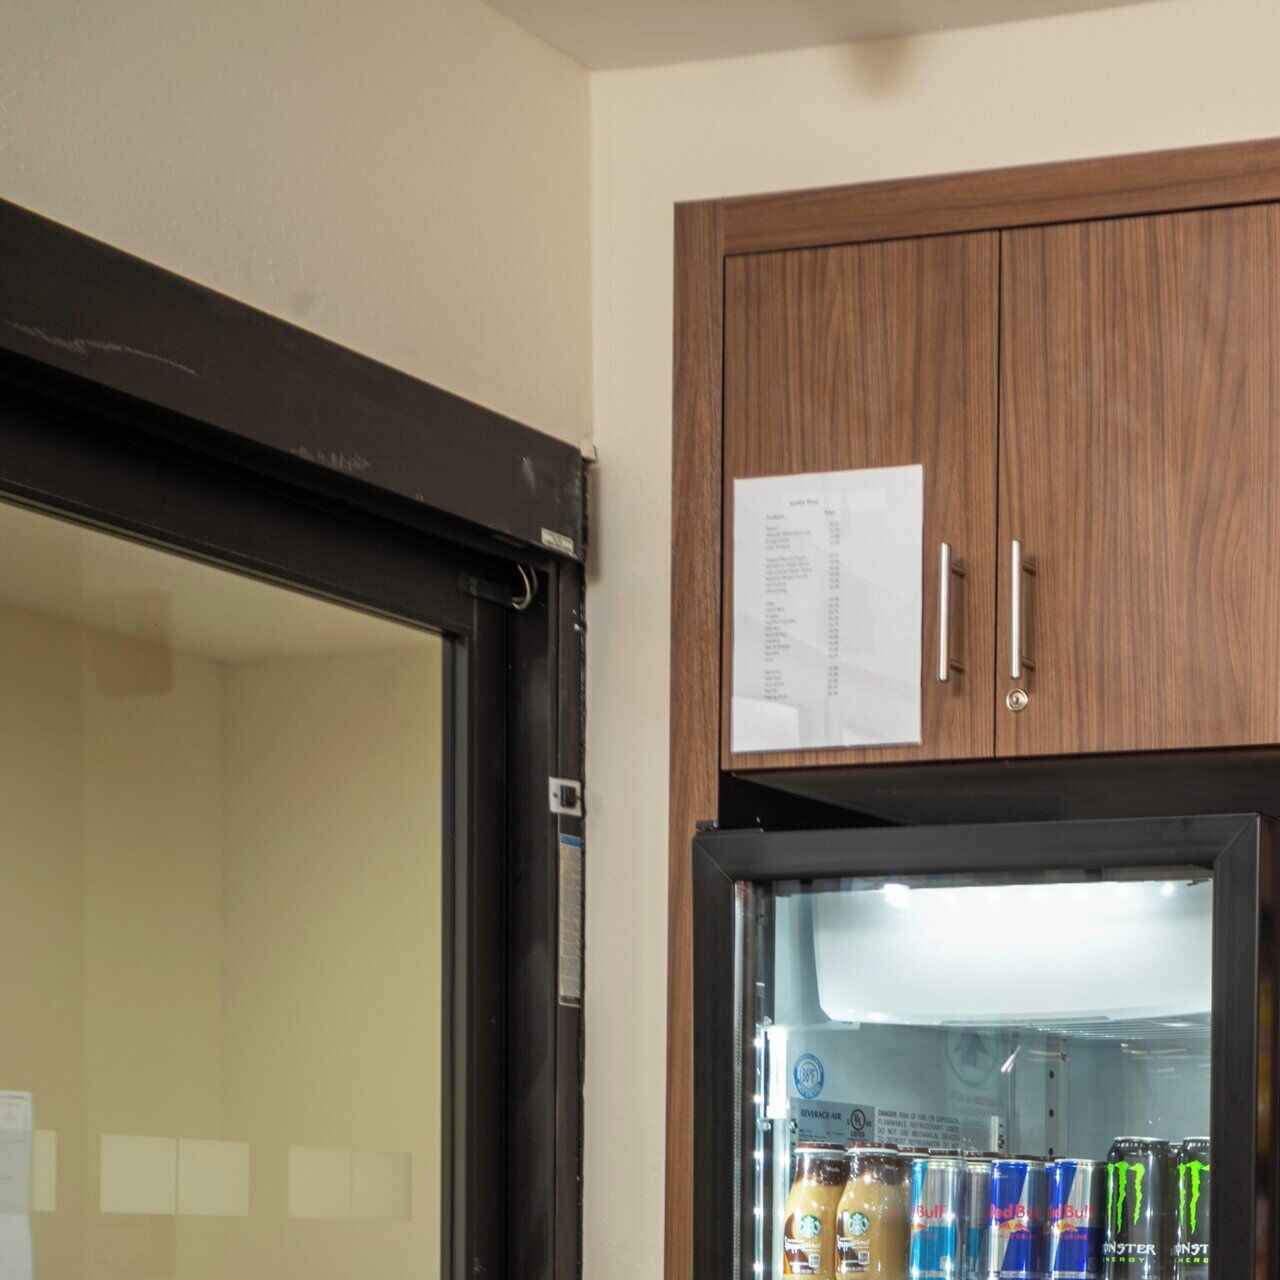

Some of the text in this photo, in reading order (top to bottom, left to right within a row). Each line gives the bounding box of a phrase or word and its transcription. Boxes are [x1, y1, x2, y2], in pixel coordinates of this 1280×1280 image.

[800, 1108, 842, 1121] BEVERAGE-AIR
[918, 1204, 944, 1219] Bull
[1103, 1241, 1157, 1256] ONSTER
